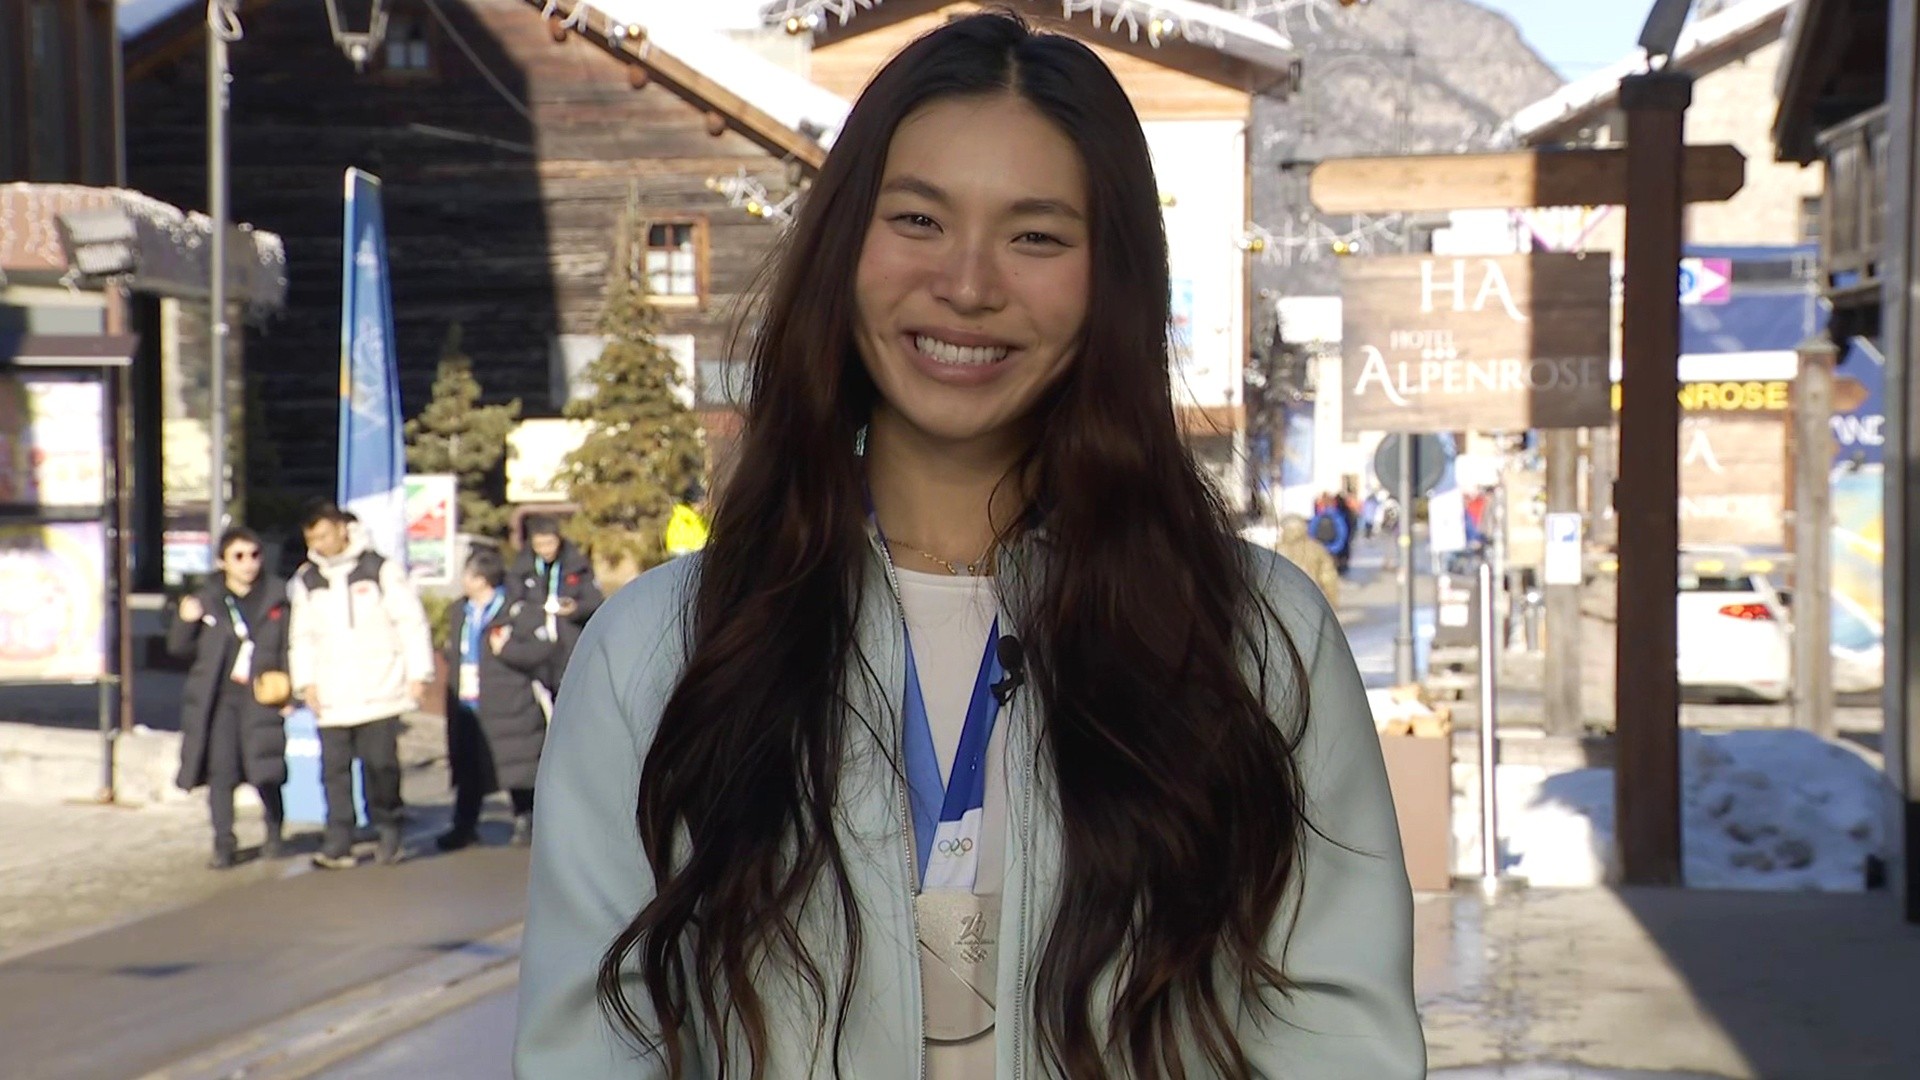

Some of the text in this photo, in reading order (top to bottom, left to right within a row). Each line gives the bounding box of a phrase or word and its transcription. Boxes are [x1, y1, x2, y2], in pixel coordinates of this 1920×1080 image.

[1420, 258, 1527, 322] HA
[1390, 329, 1454, 349] HOTEL
[1353, 345, 1597, 406] ALPENROSE
[1611, 381, 1789, 411] NROSE
